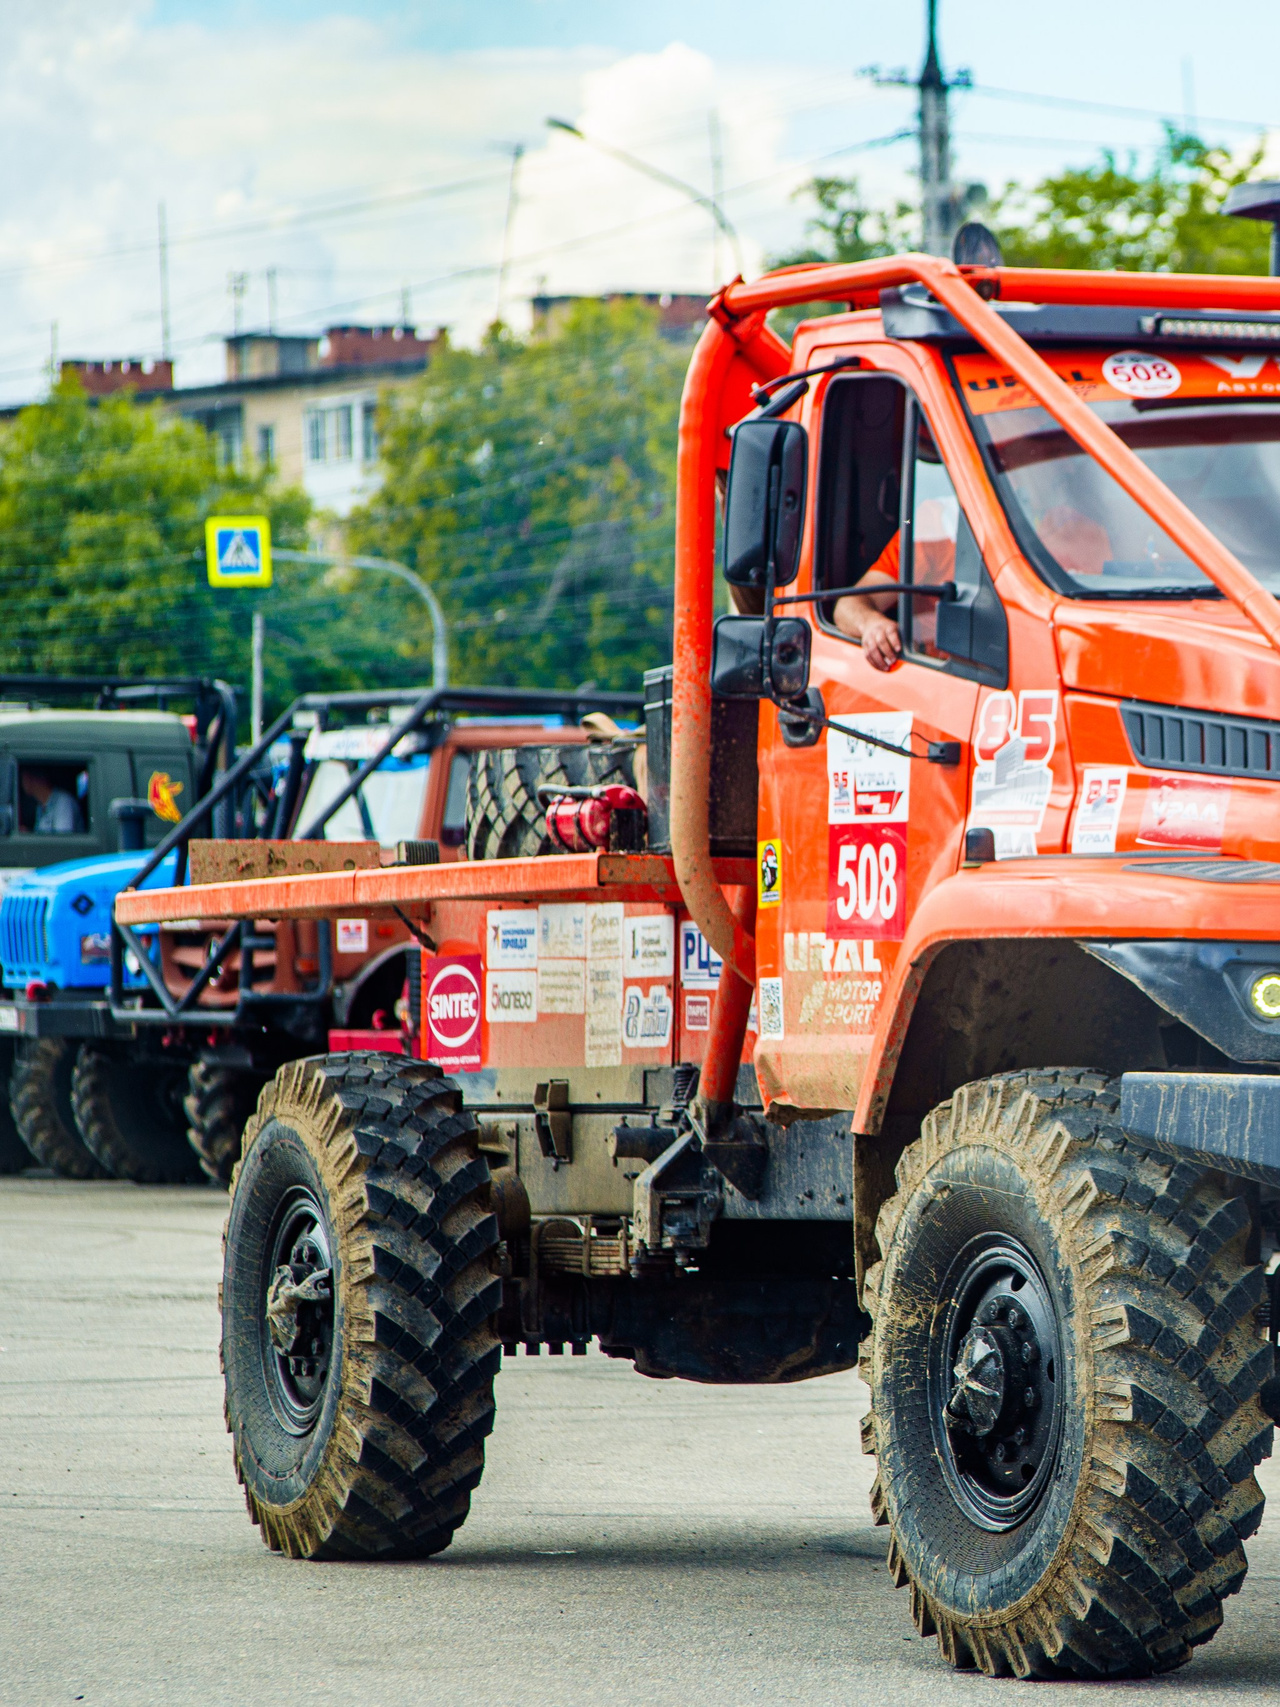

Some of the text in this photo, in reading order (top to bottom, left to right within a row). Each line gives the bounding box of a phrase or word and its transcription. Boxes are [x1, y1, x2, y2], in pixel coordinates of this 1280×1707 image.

[1112, 362, 1173, 383] 508
[974, 689, 1058, 764] 85
[1086, 778, 1121, 804] 85
[1151, 801, 1219, 821] УРАЛ
[837, 843, 897, 920] 508
[784, 932, 882, 972] URAL
[827, 981, 882, 1001] MOTOR
[431, 992, 477, 1020] SINTEC
[823, 1004, 875, 1024] SPORT
